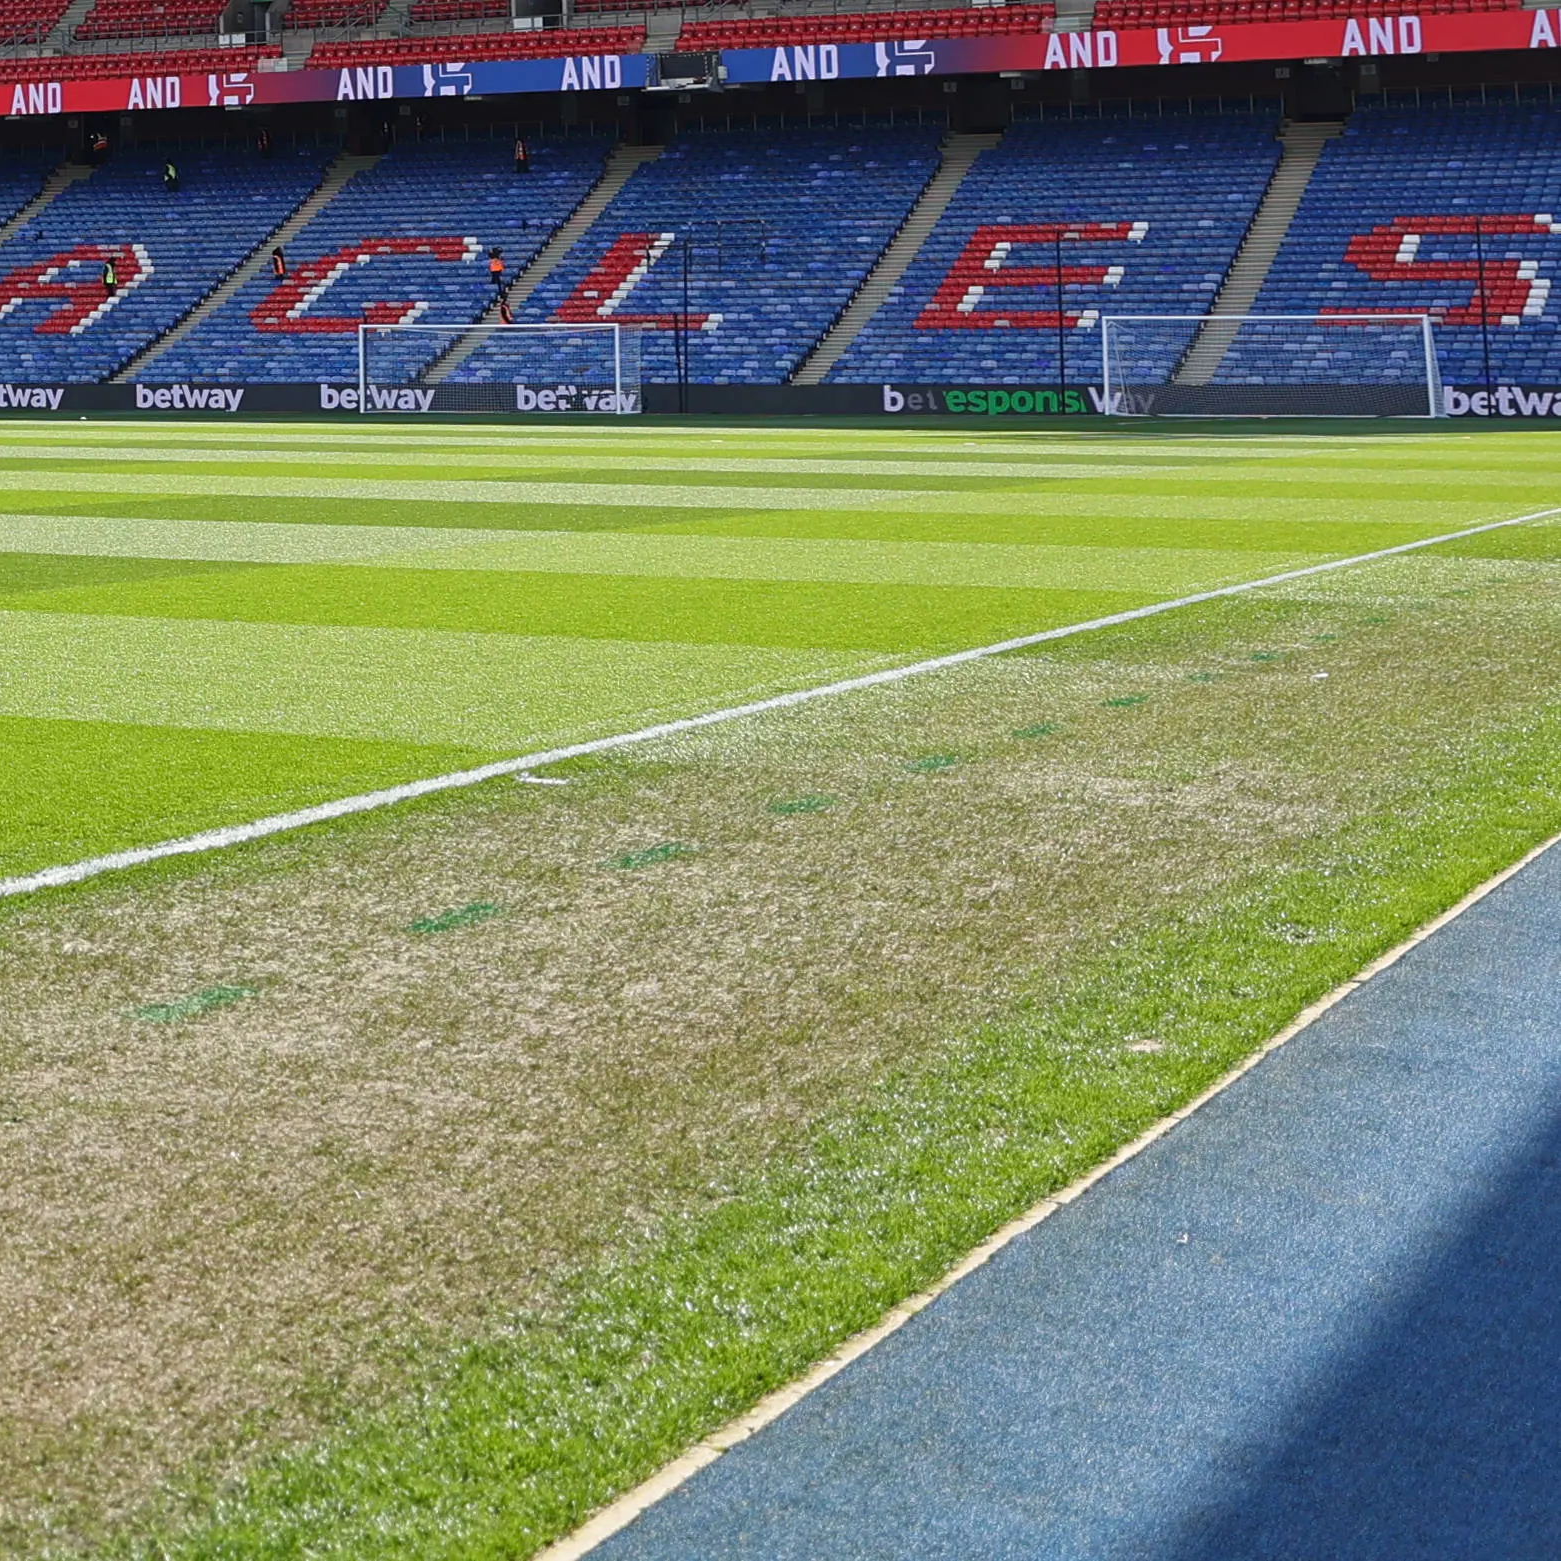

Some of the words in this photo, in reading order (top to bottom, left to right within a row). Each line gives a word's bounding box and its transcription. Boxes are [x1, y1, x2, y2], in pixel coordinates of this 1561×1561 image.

[1341, 15, 1422, 57] AND
[1530, 9, 1561, 49] A
[770, 44, 840, 82] AND
[1044, 30, 1118, 70] AND
[337, 66, 394, 101] AND
[561, 54, 622, 91] AND
[11, 82, 62, 115] AND
[127, 76, 181, 110] AND
[136, 384, 245, 411] betway
[320, 384, 434, 412] betway
